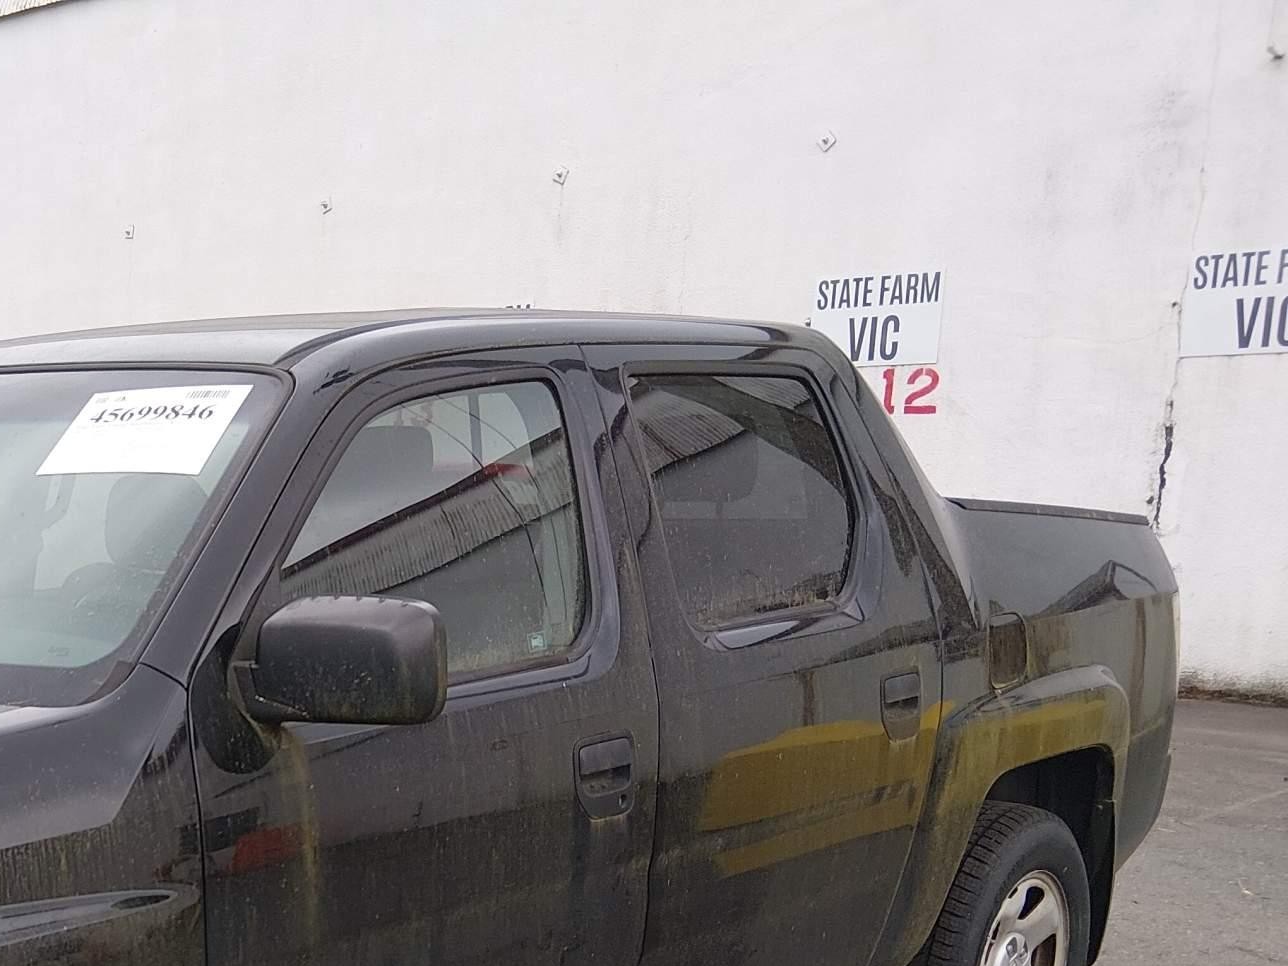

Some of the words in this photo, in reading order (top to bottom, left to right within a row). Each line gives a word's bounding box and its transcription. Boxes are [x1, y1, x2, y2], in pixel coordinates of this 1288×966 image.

[1193, 250, 1271, 290] STATE
[817, 276, 874, 311] STATE
[879, 271, 941, 306] FARM
[849, 314, 900, 362] VIC
[883, 367, 940, 415] 12
[90, 404, 217, 424] 45699846
